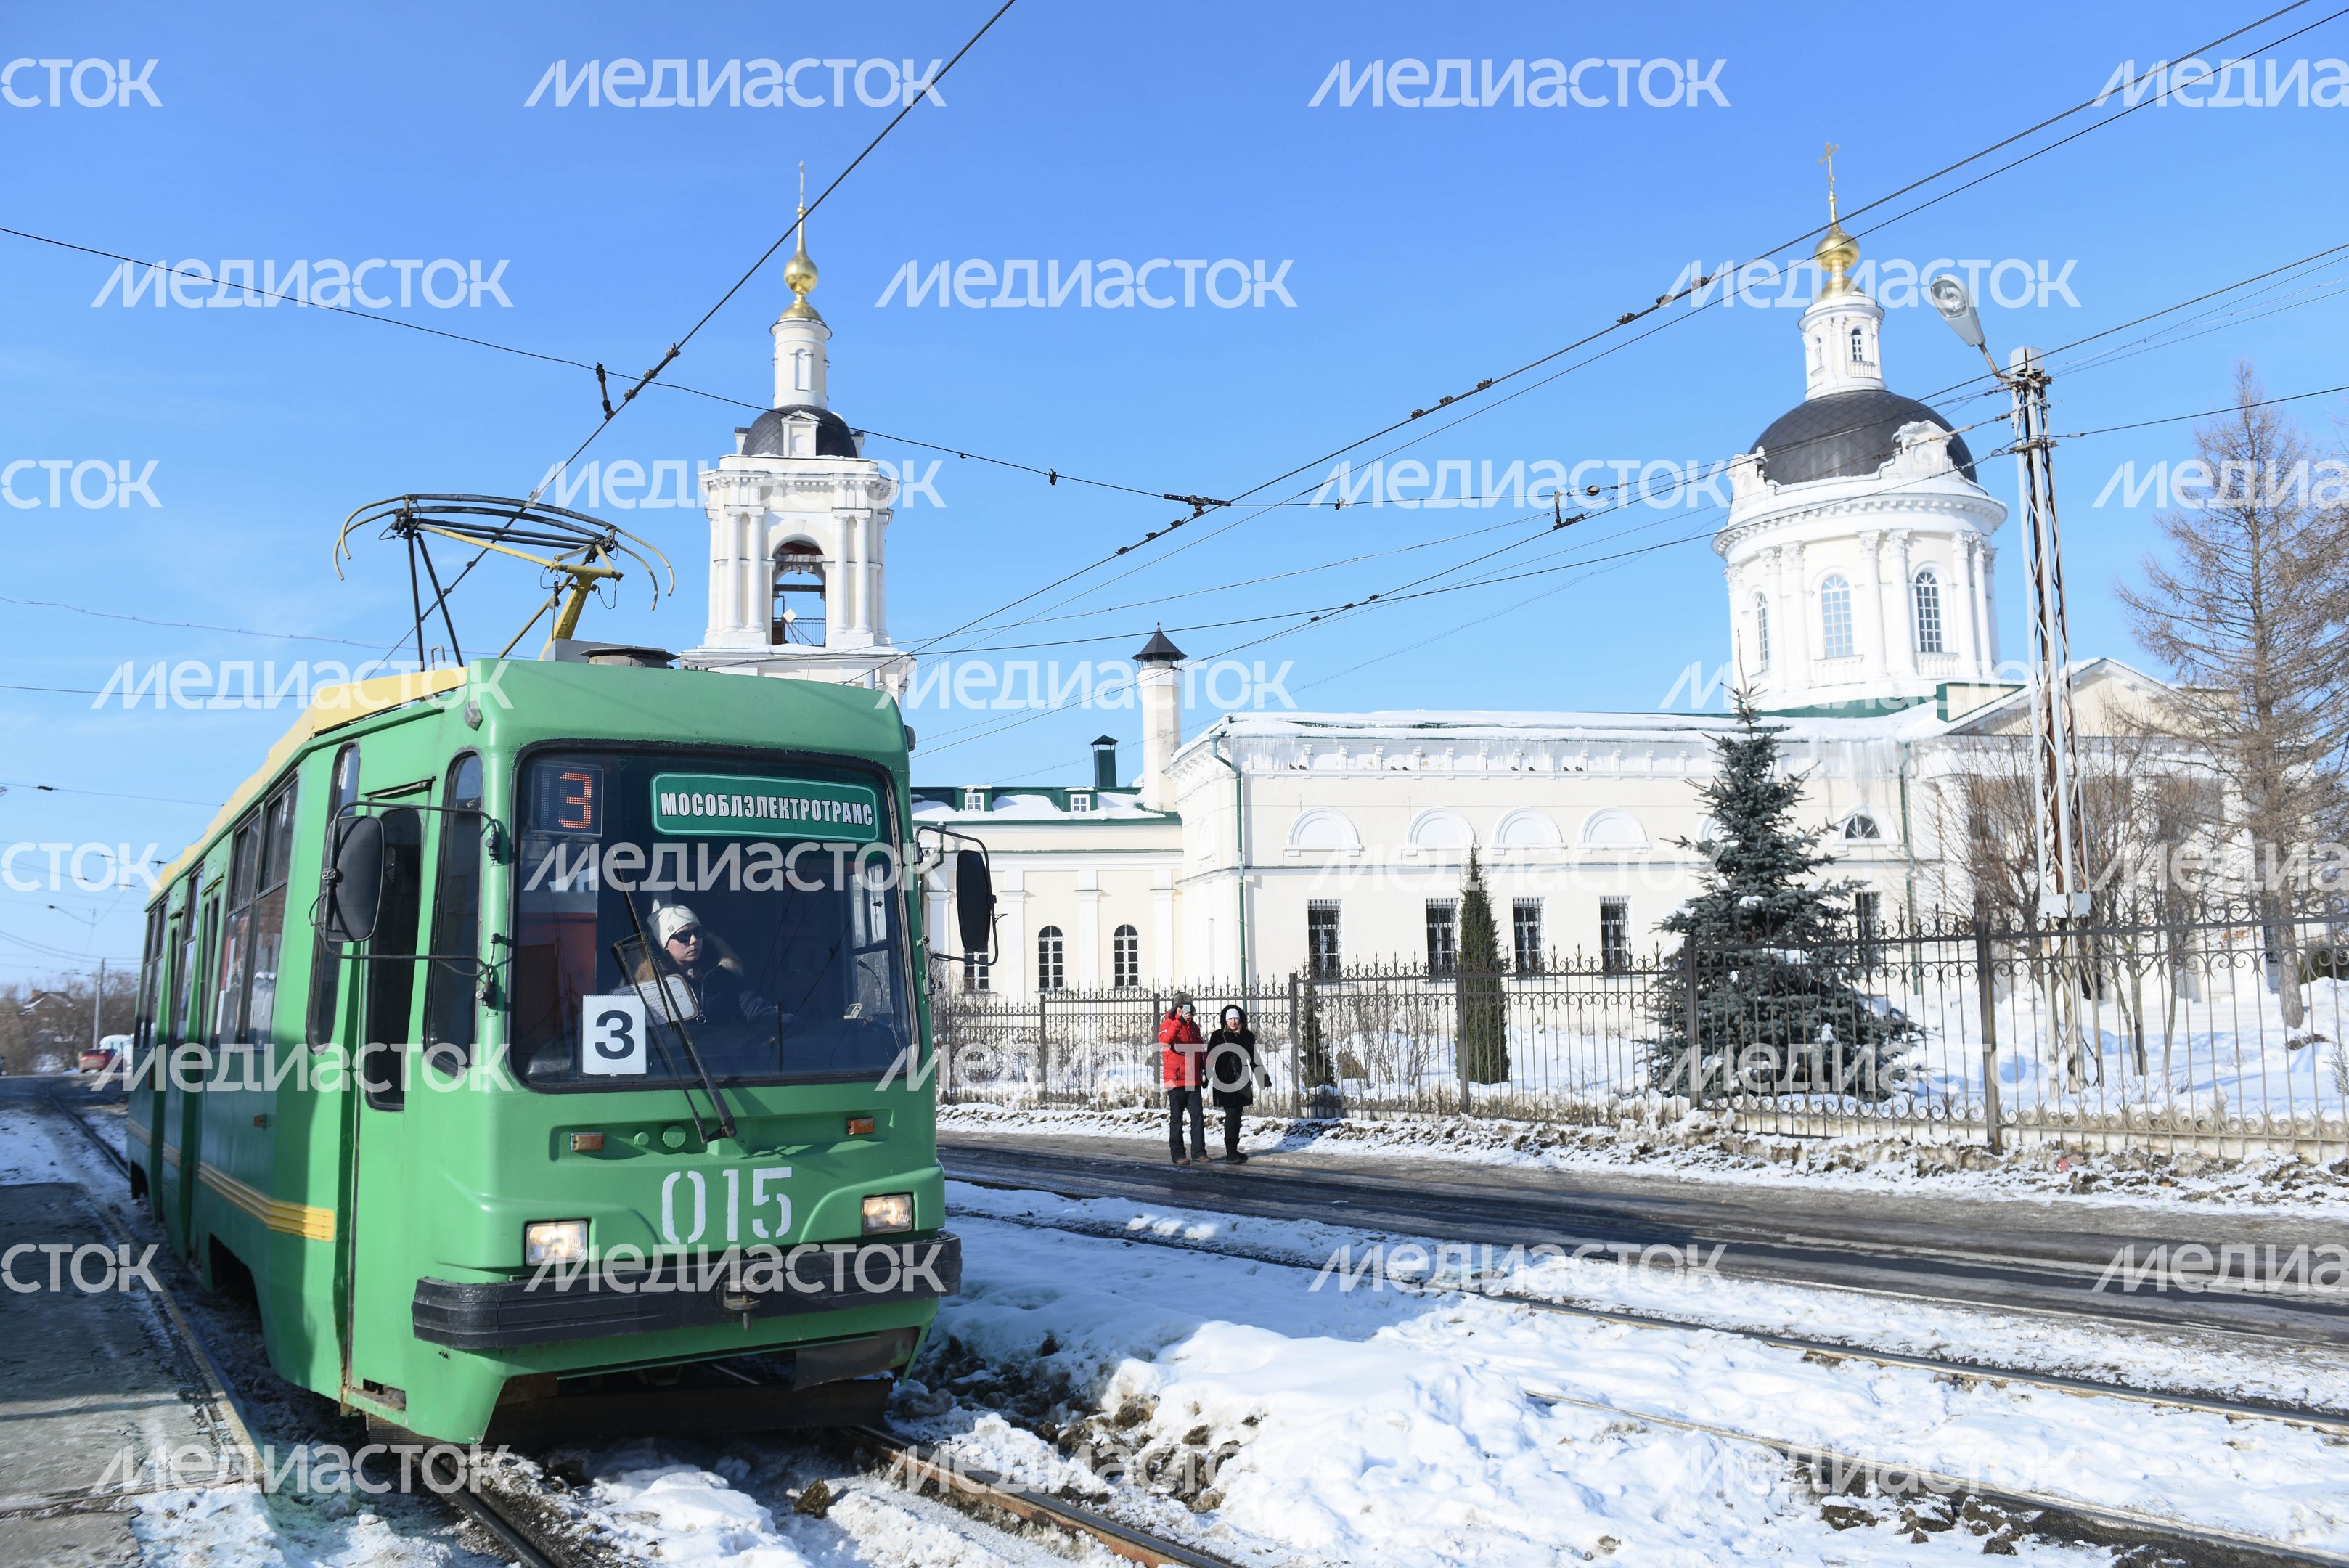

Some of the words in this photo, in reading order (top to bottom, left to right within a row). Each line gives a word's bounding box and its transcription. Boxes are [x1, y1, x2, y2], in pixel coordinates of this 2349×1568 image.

[558, 772, 592, 828] 3
[660, 792, 873, 826] МОСОБЛЭЛЕКТРОТРАНС
[595, 1010, 635, 1060] 3
[661, 1167, 792, 1245] 015
